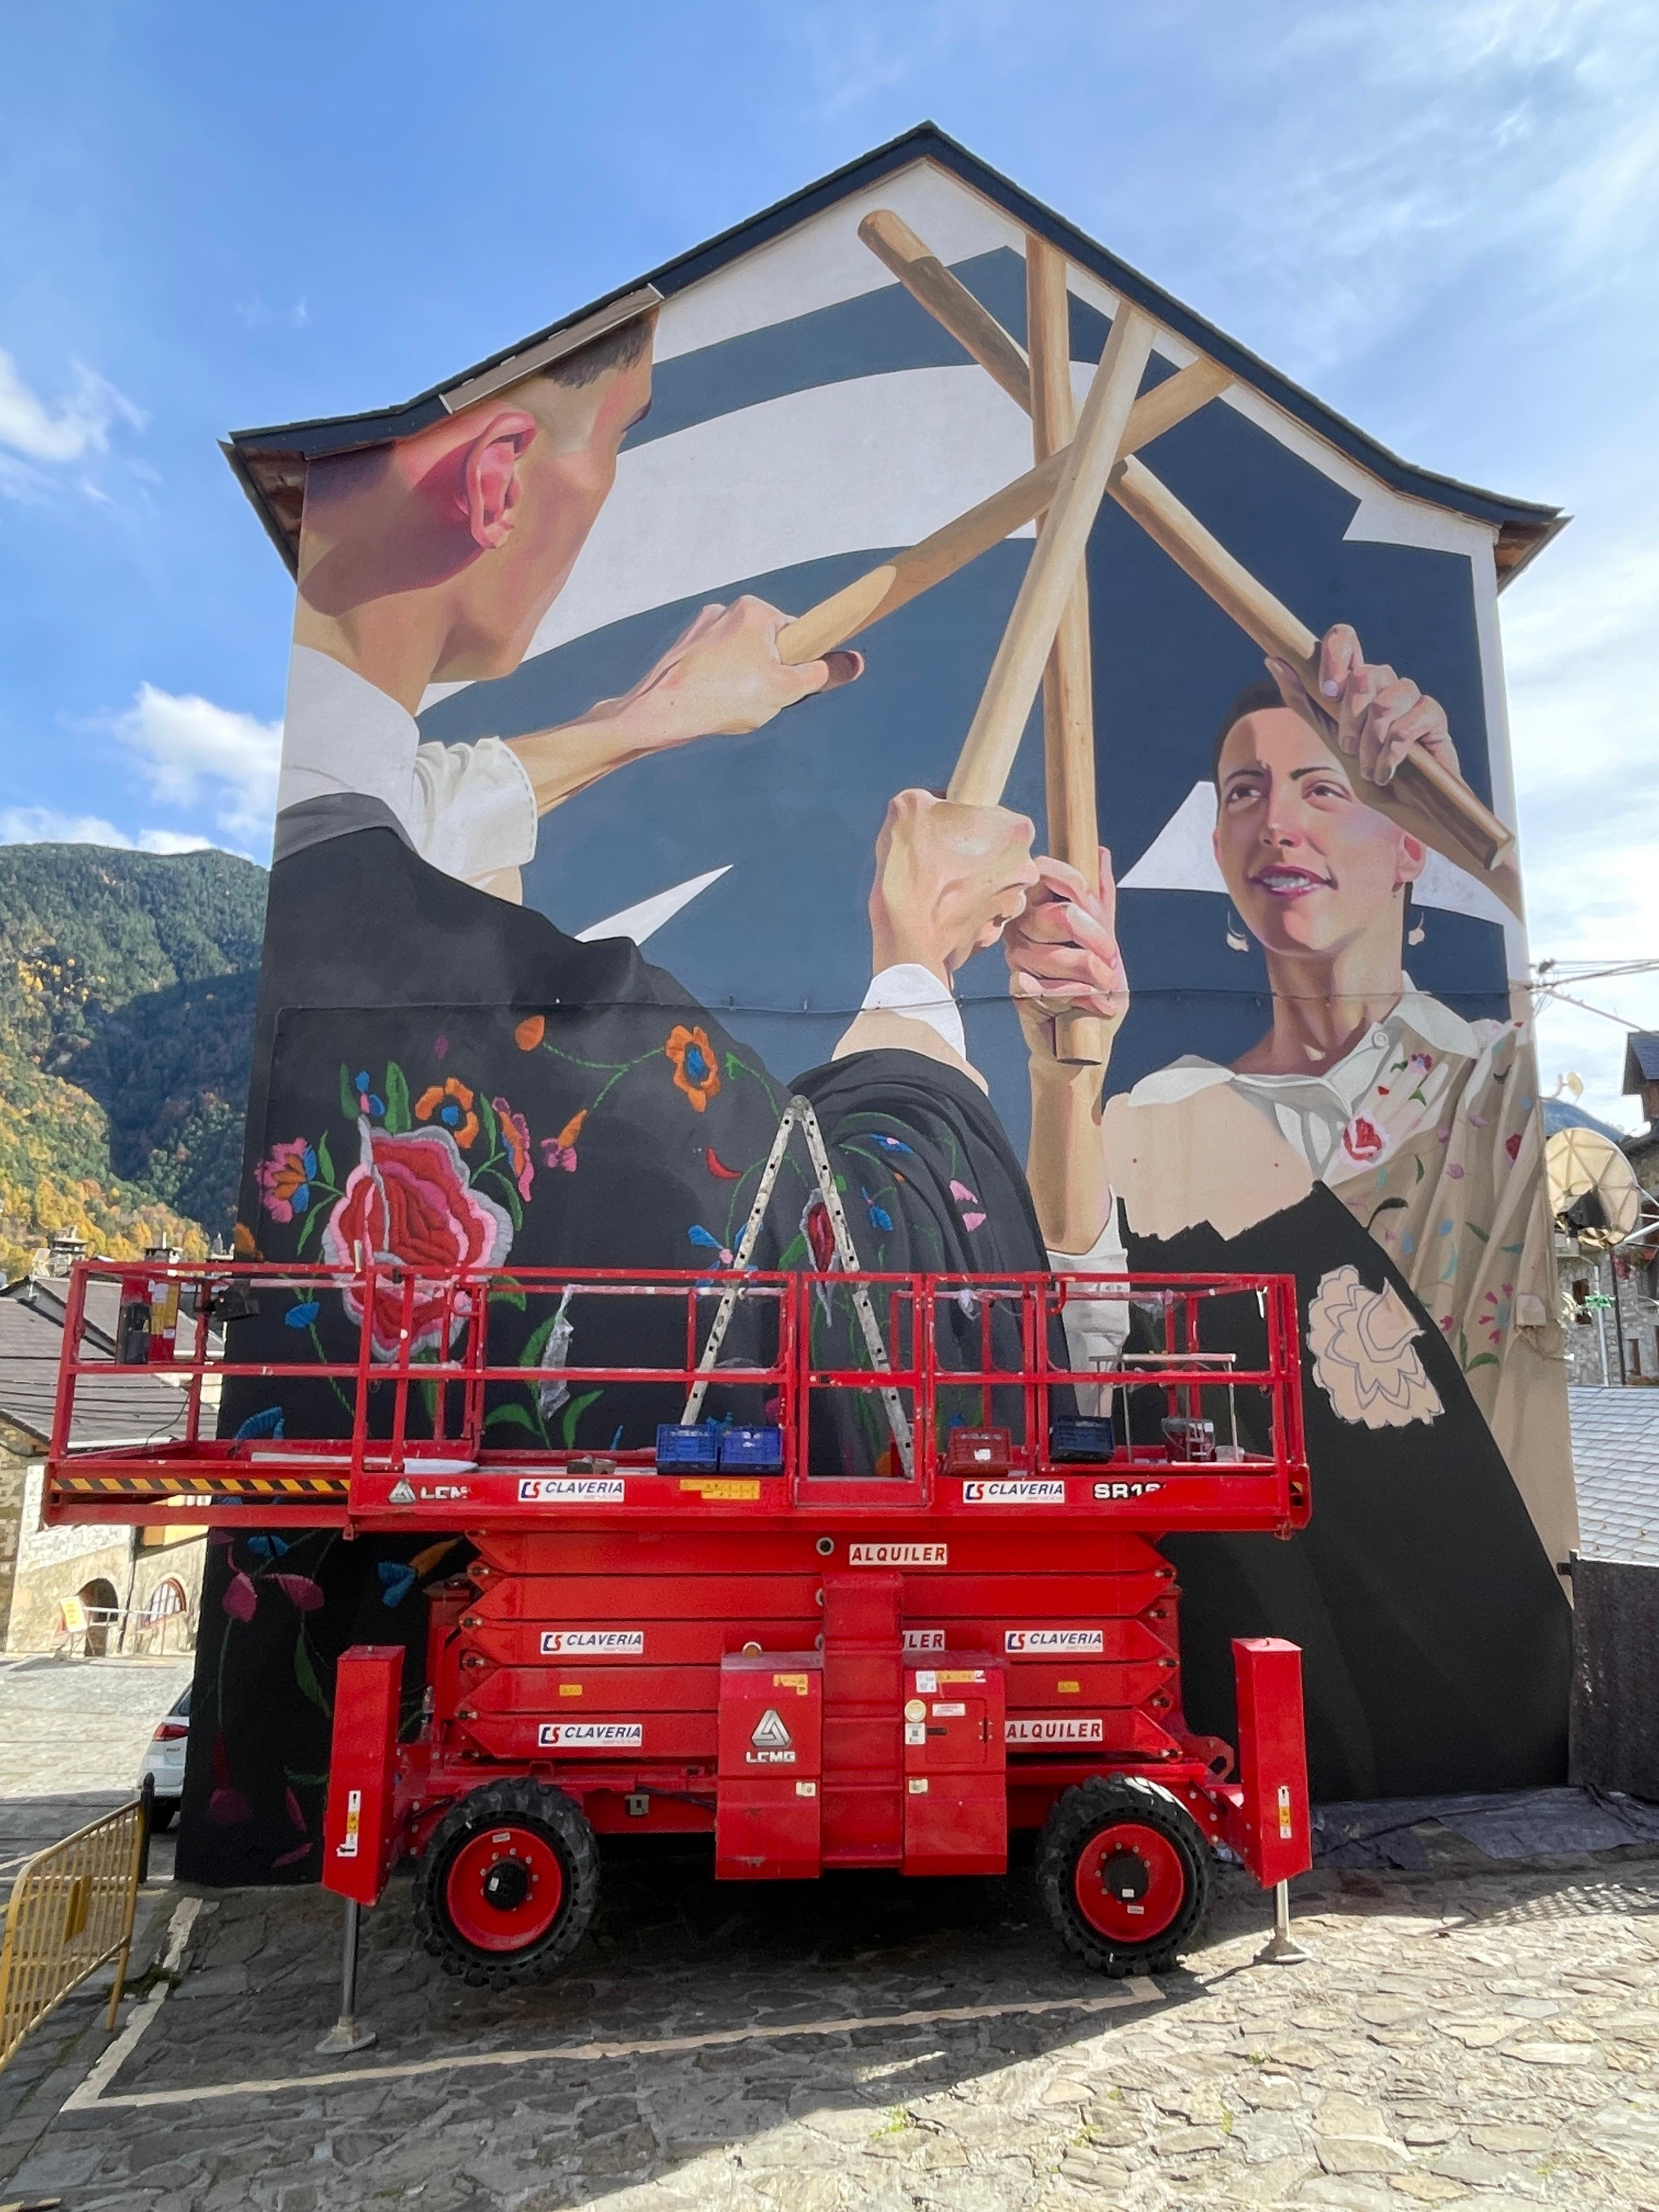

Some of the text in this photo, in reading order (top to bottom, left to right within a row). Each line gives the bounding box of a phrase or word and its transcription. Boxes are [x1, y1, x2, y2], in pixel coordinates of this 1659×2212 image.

[545, 1481, 623, 1493] CLAVERIA
[989, 1483, 1063, 1495] CLAVERIA
[851, 1547, 945, 1561] ALQUILER
[566, 1634, 641, 1646] CLAVERIA
[1030, 1633, 1102, 1645] CLAVERIA
[564, 1726, 640, 1739] CLAVERIA
[1006, 1723, 1101, 1738] ALQUILER
